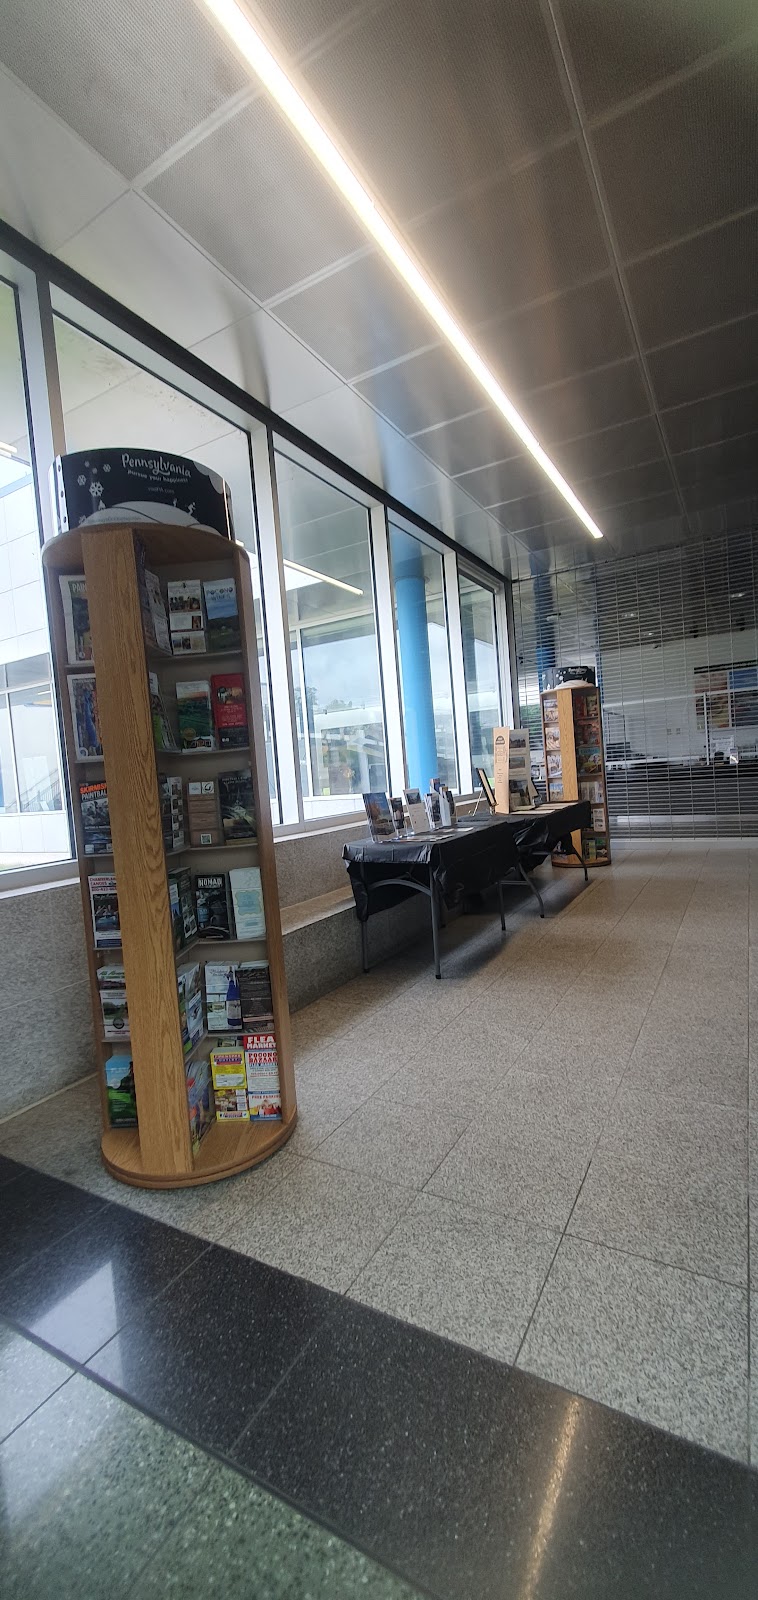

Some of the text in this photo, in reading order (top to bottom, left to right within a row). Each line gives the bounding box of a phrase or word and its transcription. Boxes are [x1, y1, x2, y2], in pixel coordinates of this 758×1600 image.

[121, 452, 192, 478] Pennsylvania
[81, 790, 107, 801] PAINTBAL
[247, 1035, 275, 1044] FLEA
